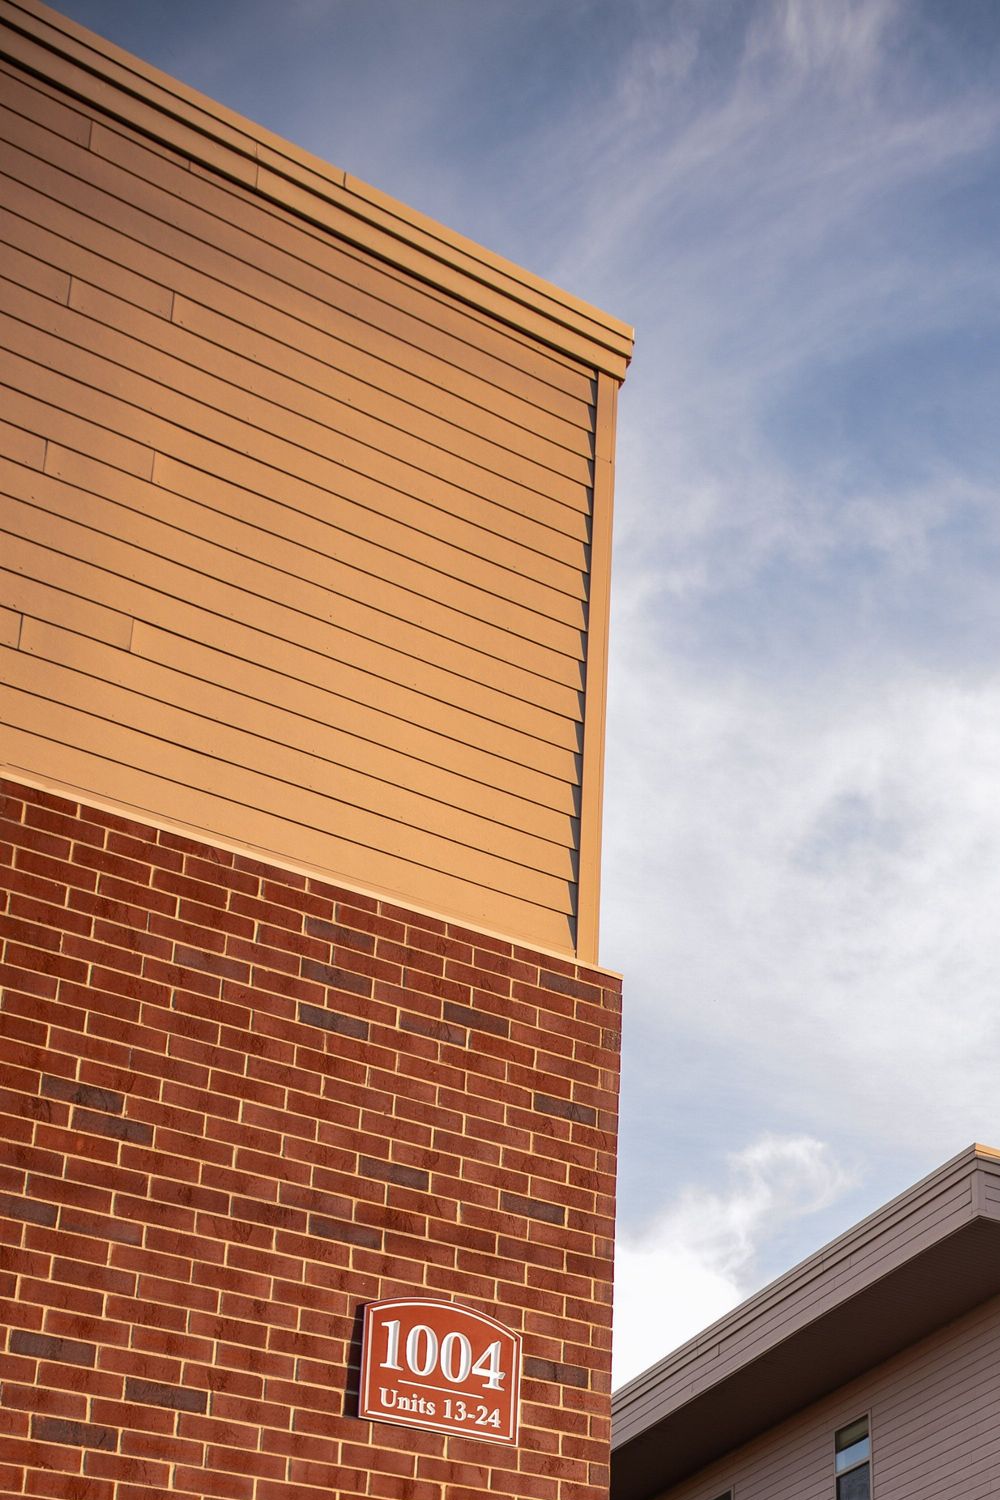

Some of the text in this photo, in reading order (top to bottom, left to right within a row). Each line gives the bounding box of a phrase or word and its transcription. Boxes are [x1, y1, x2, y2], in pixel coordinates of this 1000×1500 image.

[379, 1319, 506, 1392] 1004
[379, 1387, 501, 1428] Units 13-24
